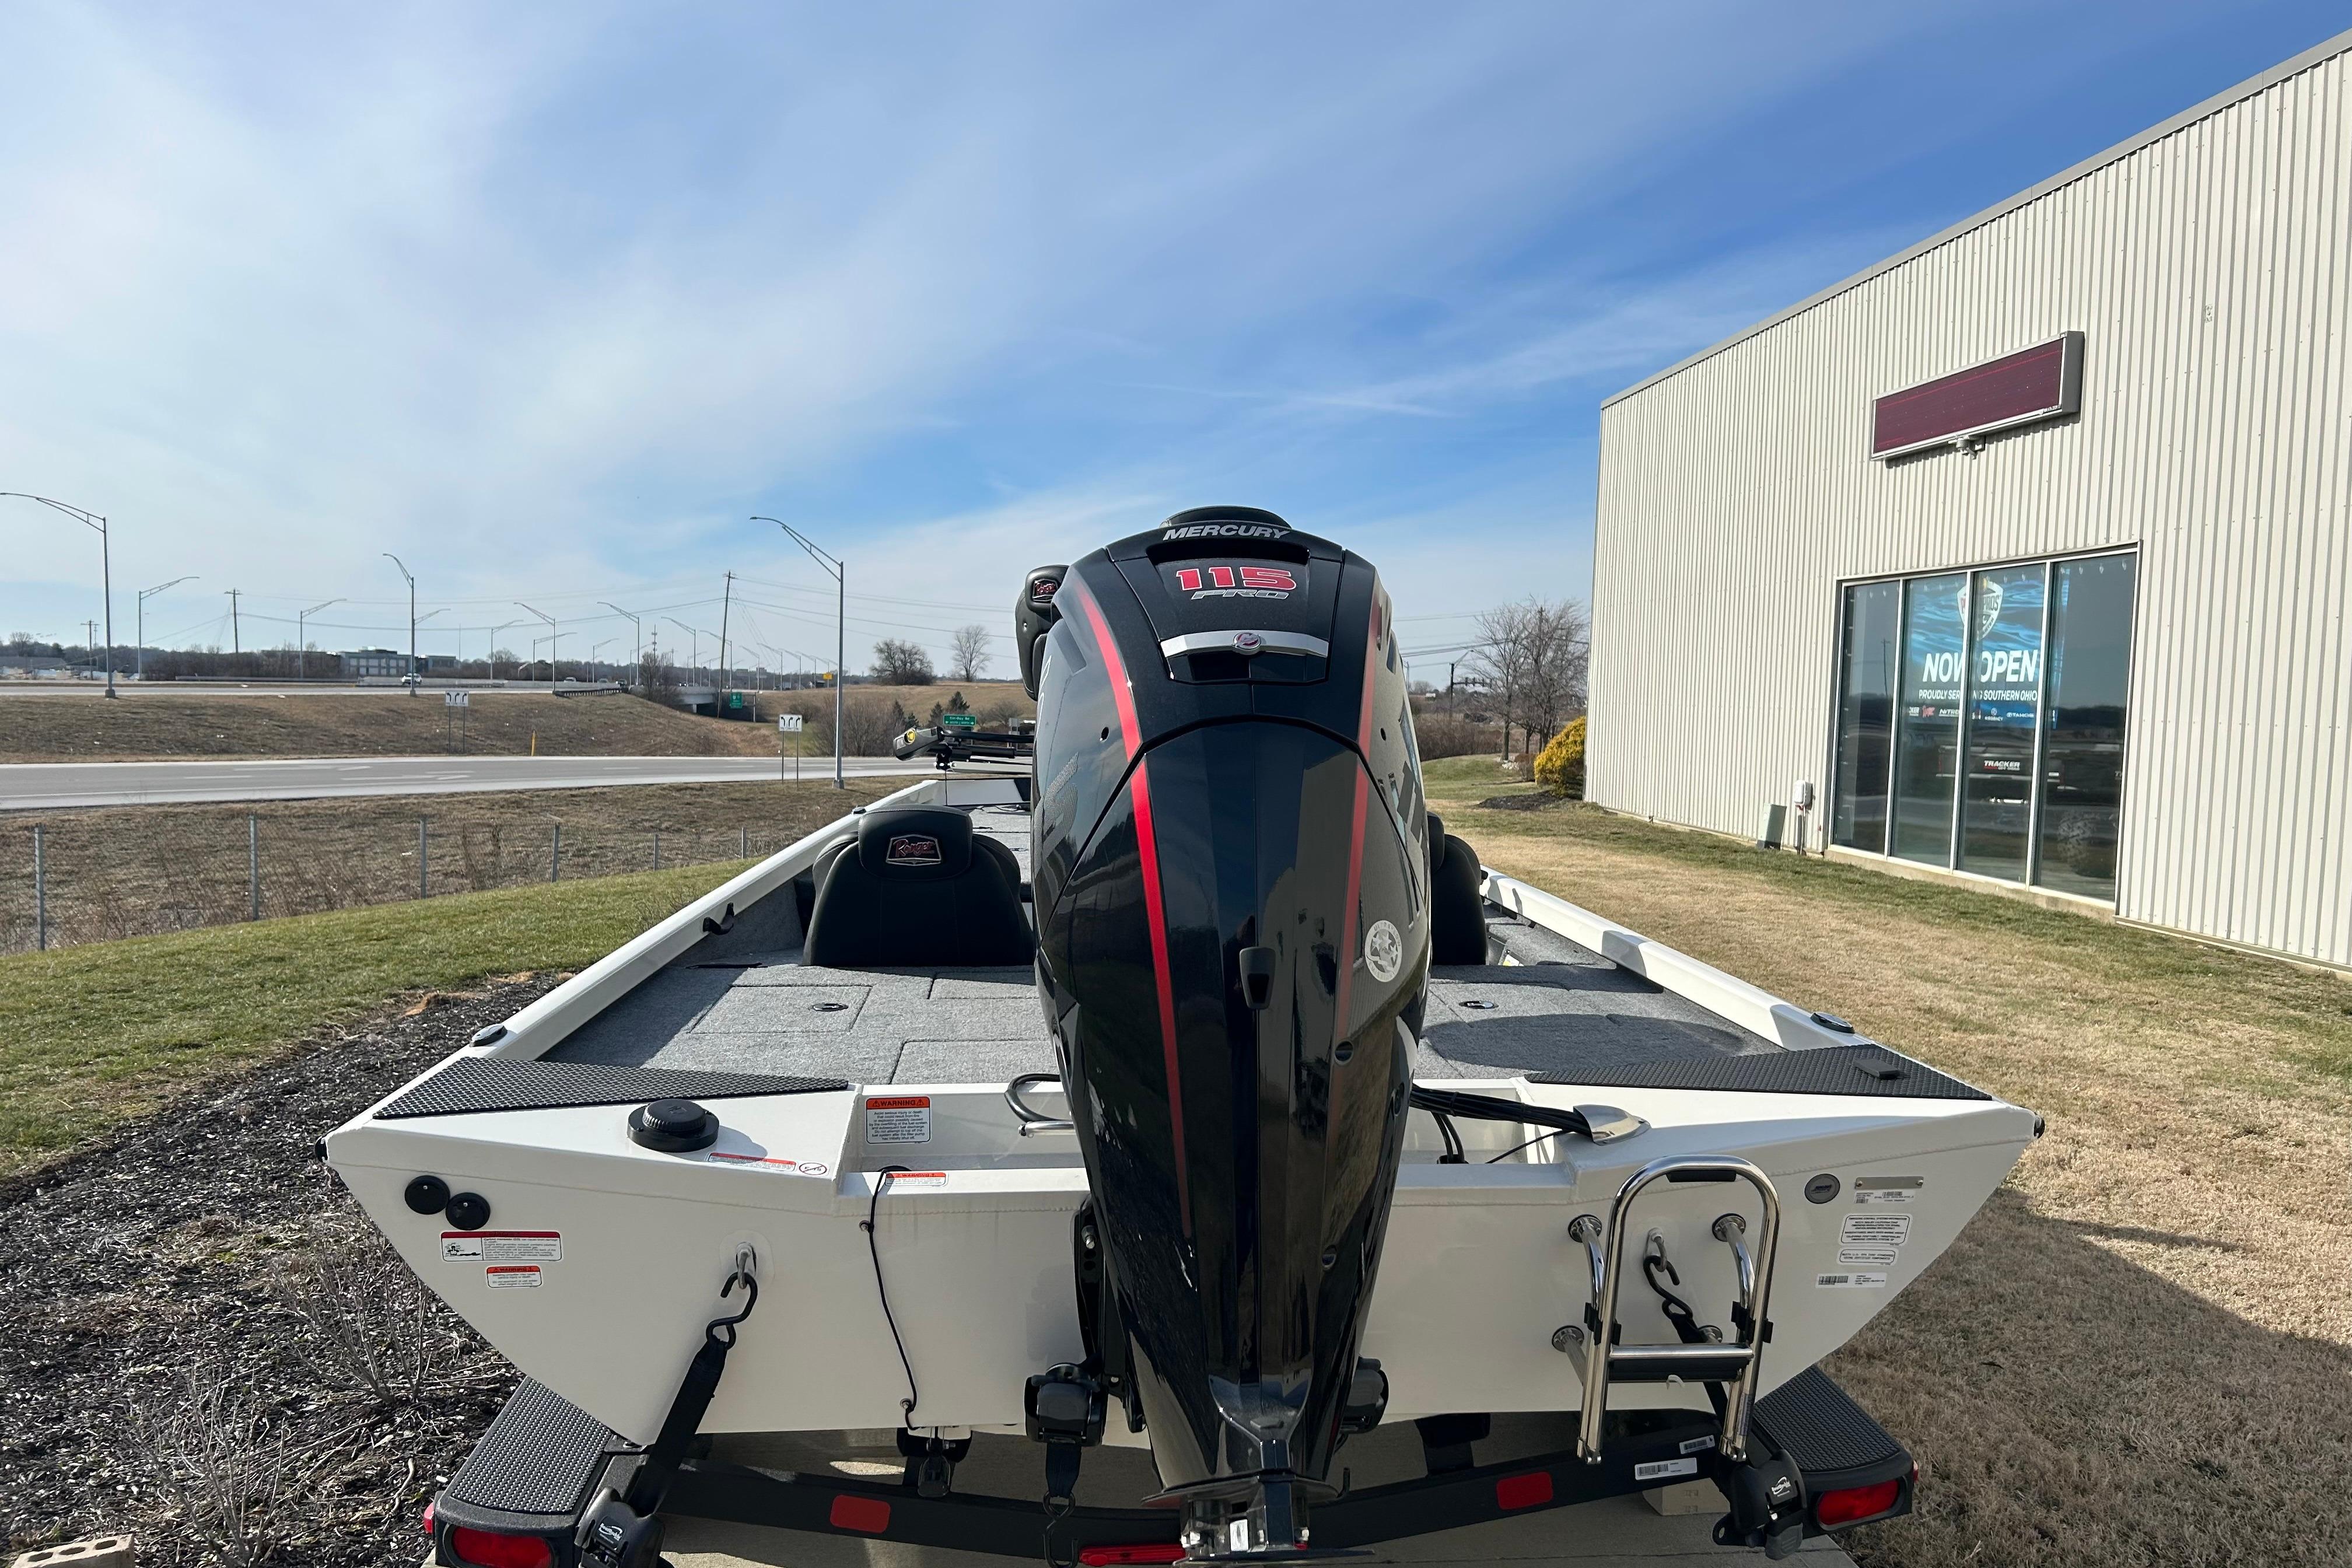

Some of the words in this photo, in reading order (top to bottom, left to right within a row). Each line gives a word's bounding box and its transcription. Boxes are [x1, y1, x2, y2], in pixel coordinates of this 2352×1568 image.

[1163, 524, 1290, 541] MERCURY
[1176, 566, 1297, 592] 115
[1191, 589, 1290, 600] PRO
[1919, 689, 1947, 700] PROUDLY
[1983, 690, 2020, 701] SOUTHERN
[2020, 690, 2038, 701] OHIO
[893, 839, 935, 858] Ranger
